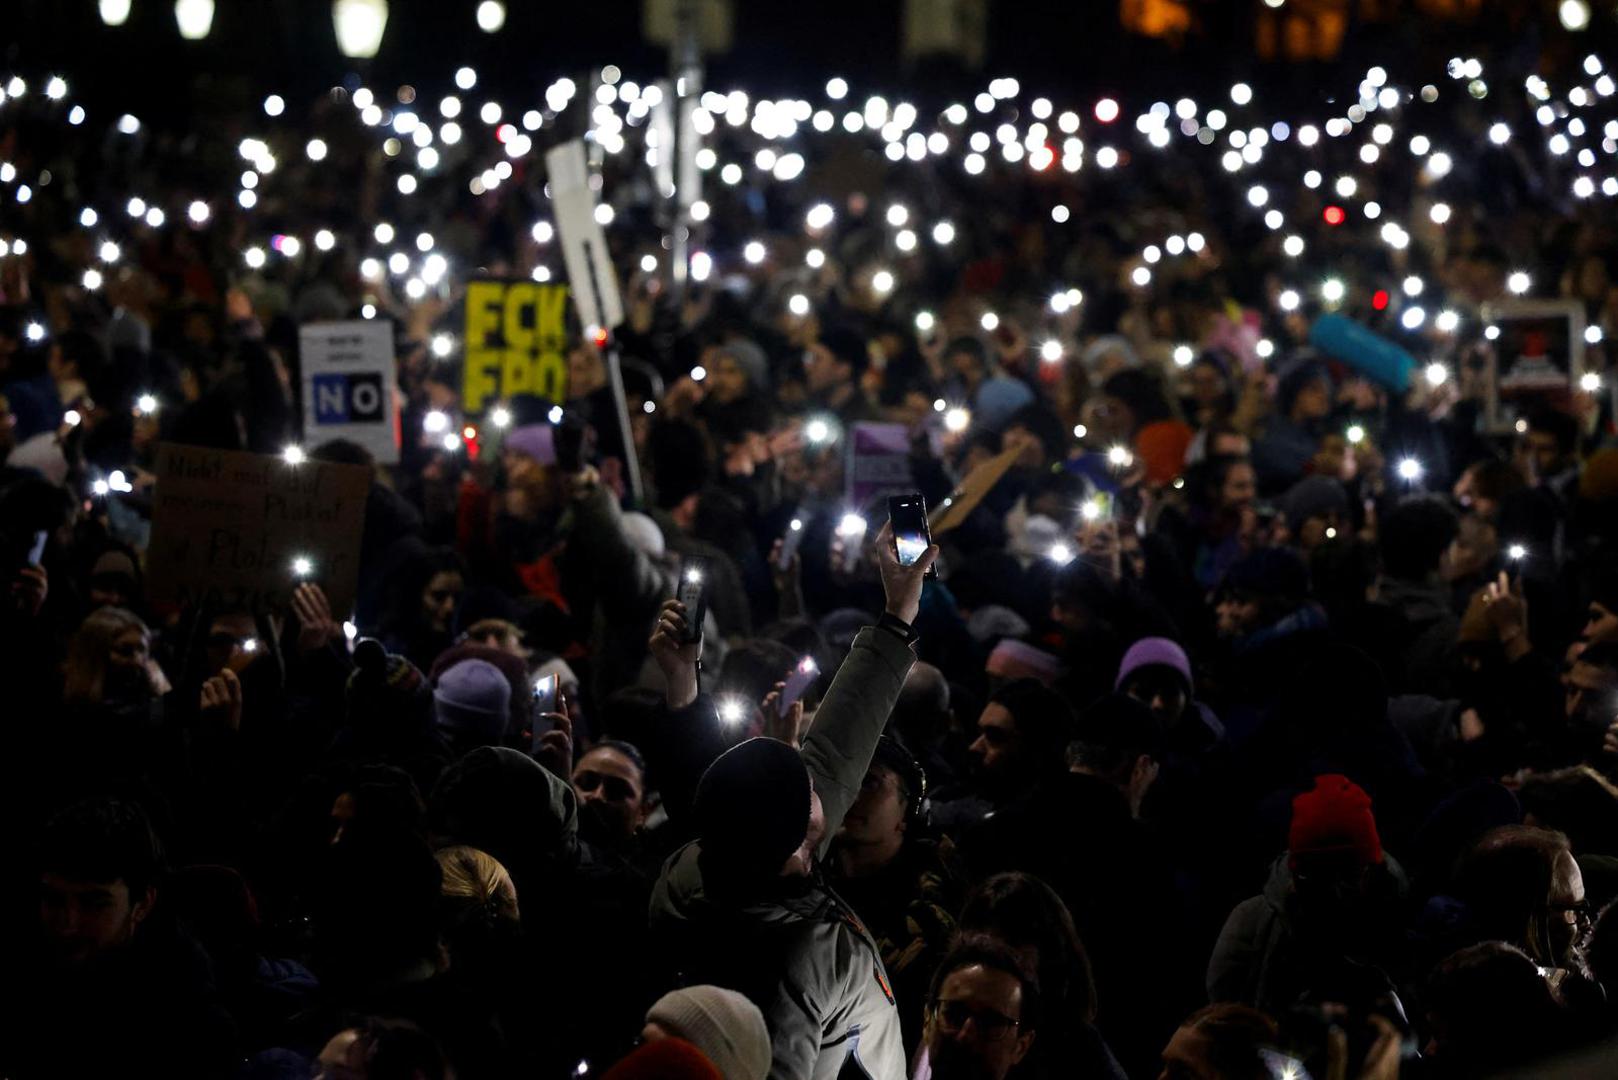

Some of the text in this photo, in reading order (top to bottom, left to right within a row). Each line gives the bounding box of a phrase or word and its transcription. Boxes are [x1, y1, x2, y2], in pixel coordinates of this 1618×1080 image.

[466, 282, 567, 350] FCK
[318, 380, 380, 416] NO
[167, 454, 222, 480] Nicht
[233, 464, 271, 486] mal
[263, 492, 345, 522] Plakat
